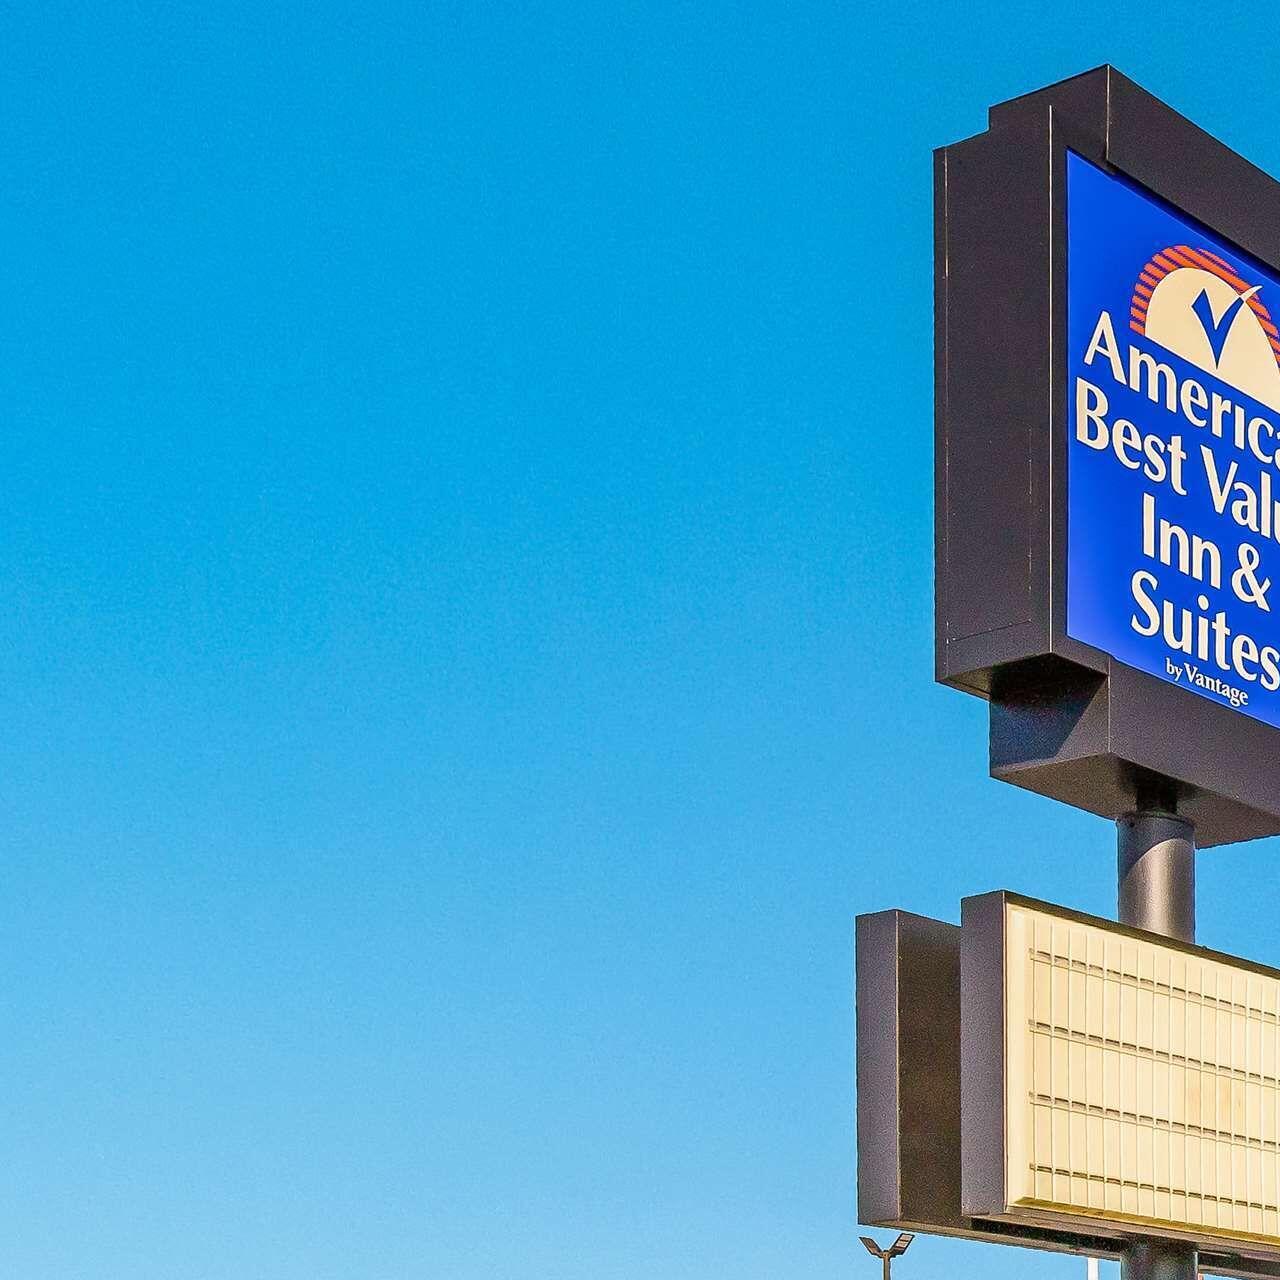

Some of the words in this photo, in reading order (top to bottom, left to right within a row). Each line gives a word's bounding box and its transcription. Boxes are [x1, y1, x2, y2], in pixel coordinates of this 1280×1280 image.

[1076, 376, 1188, 496] Best
[1143, 492, 1221, 590] Inn
[1231, 542, 1272, 612] &
[1165, 657, 1183, 681] by
[1183, 662, 1249, 706] Vantage
